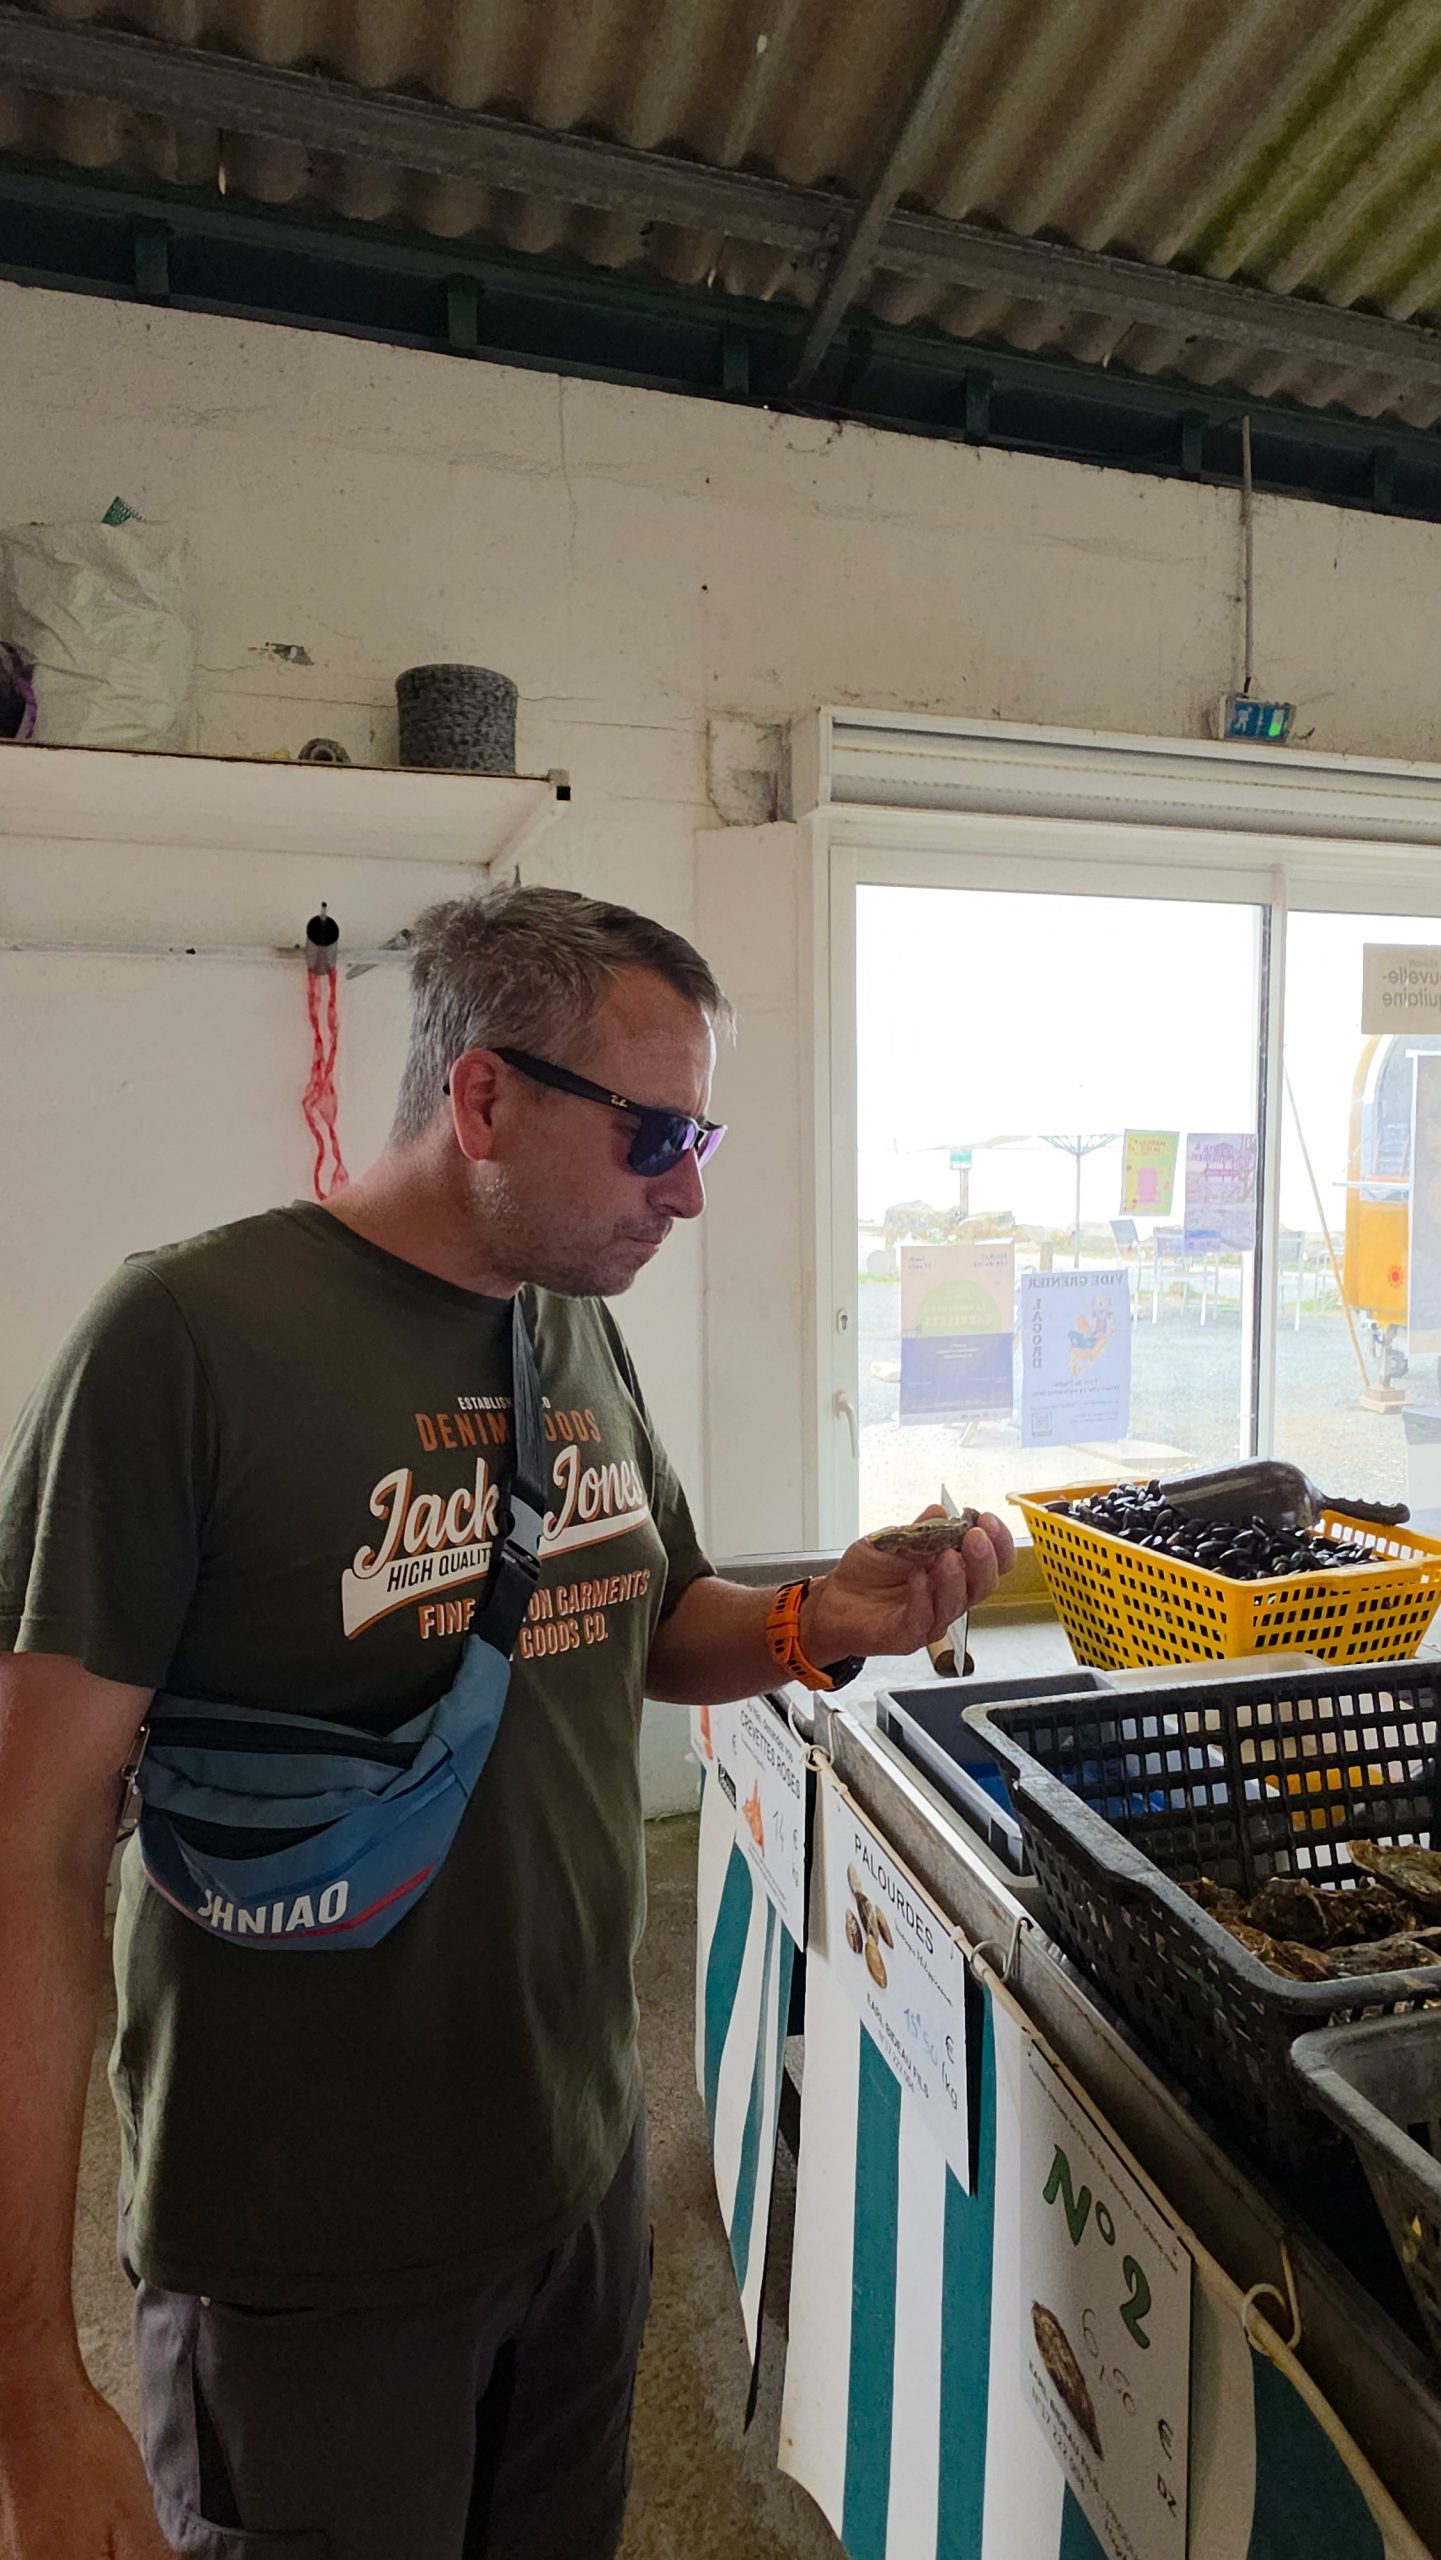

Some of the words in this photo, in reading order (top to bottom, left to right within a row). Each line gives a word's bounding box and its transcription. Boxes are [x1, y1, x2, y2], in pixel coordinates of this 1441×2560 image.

[415, 1410, 510, 1452] DENIM
[545, 1407, 602, 1444] OODS
[352, 1456, 500, 1580] Jack
[543, 1444, 646, 1543] Jones
[386, 1559, 434, 1593] HIGH
[438, 1548, 492, 1579] QUALIT
[555, 1567, 651, 1616] GARMENTS
[518, 1617, 581, 1661] GOODS
[776, 1754, 801, 1801] ROSES
[854, 1832, 934, 1956] PALOURDES
[945, 2034, 955, 2065] €
[1119, 2254, 1153, 2350] 2
[1157, 2418, 1173, 2461] €
[1156, 2471, 1177, 2519] DZ
